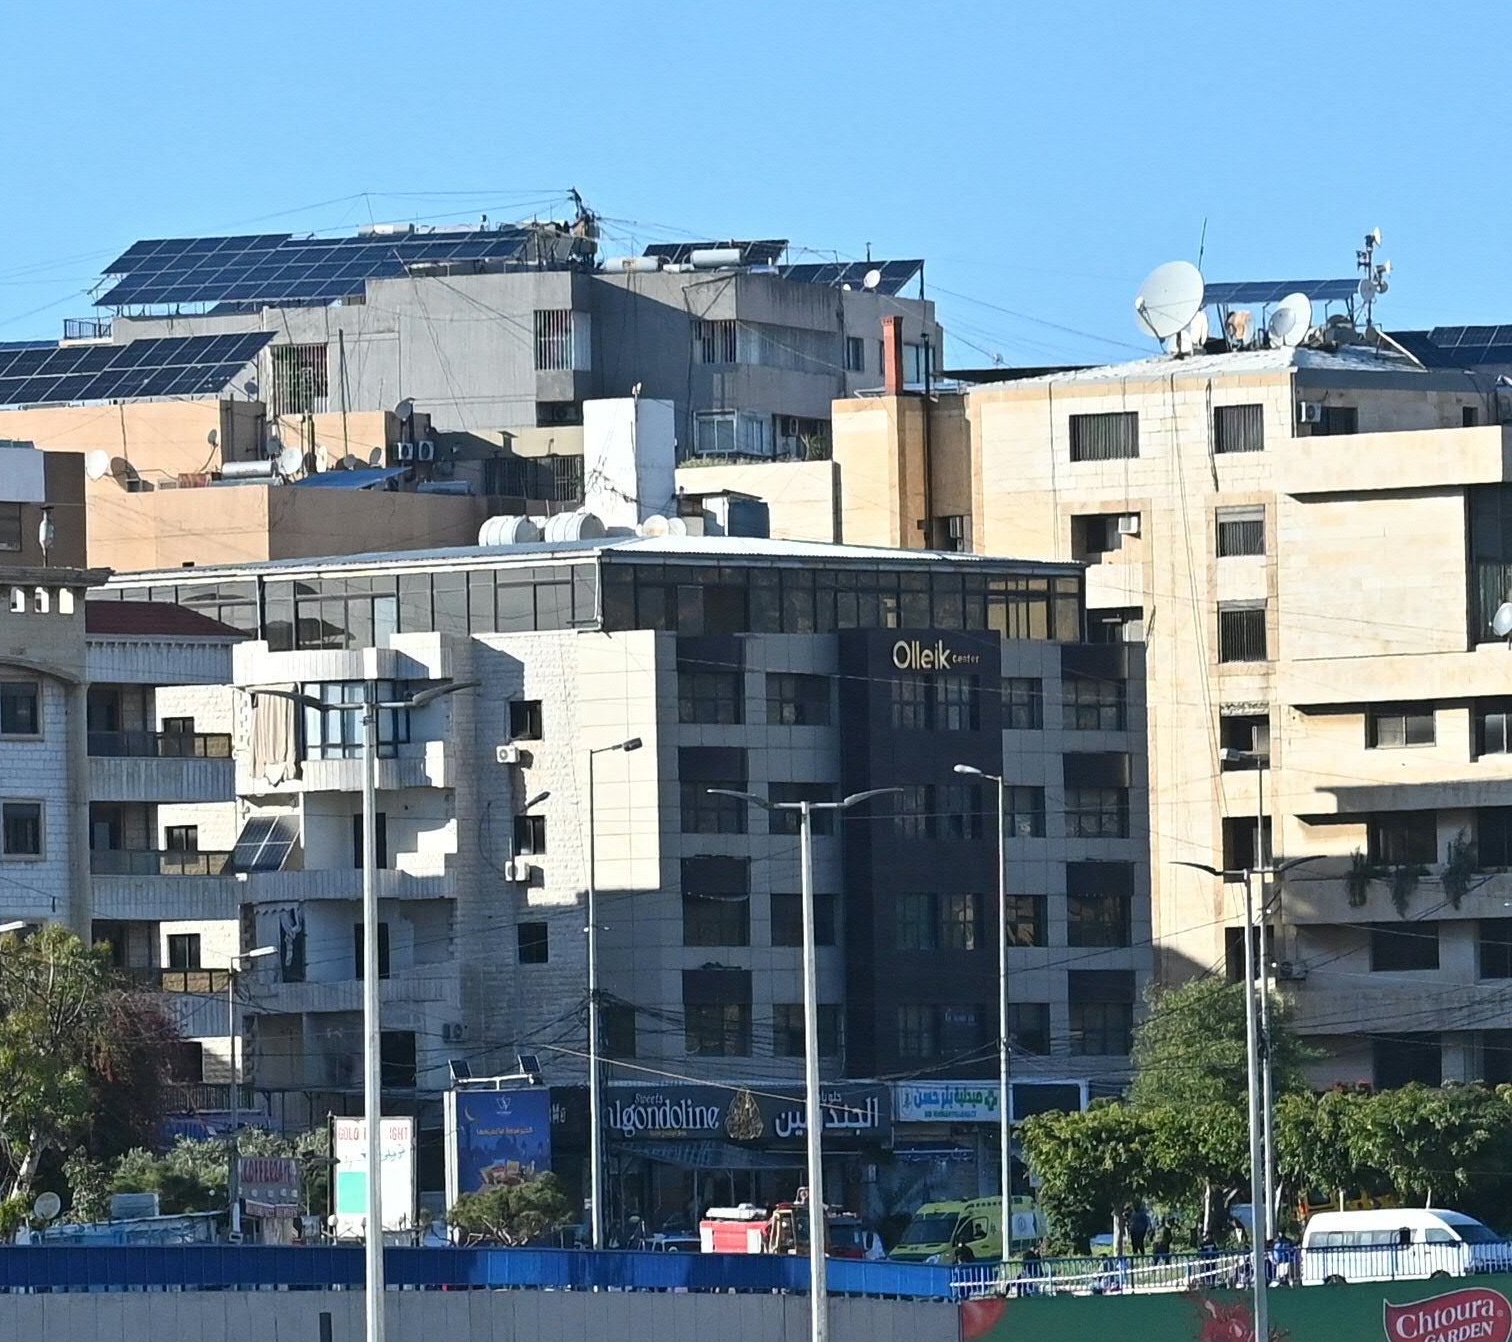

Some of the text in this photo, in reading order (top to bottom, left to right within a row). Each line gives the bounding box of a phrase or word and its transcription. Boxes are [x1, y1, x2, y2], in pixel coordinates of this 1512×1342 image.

[893, 639, 951, 670] Olleik
[821, 1091, 842, 1104] حلويا
[1396, 1299, 1495, 1339] Chtoura
